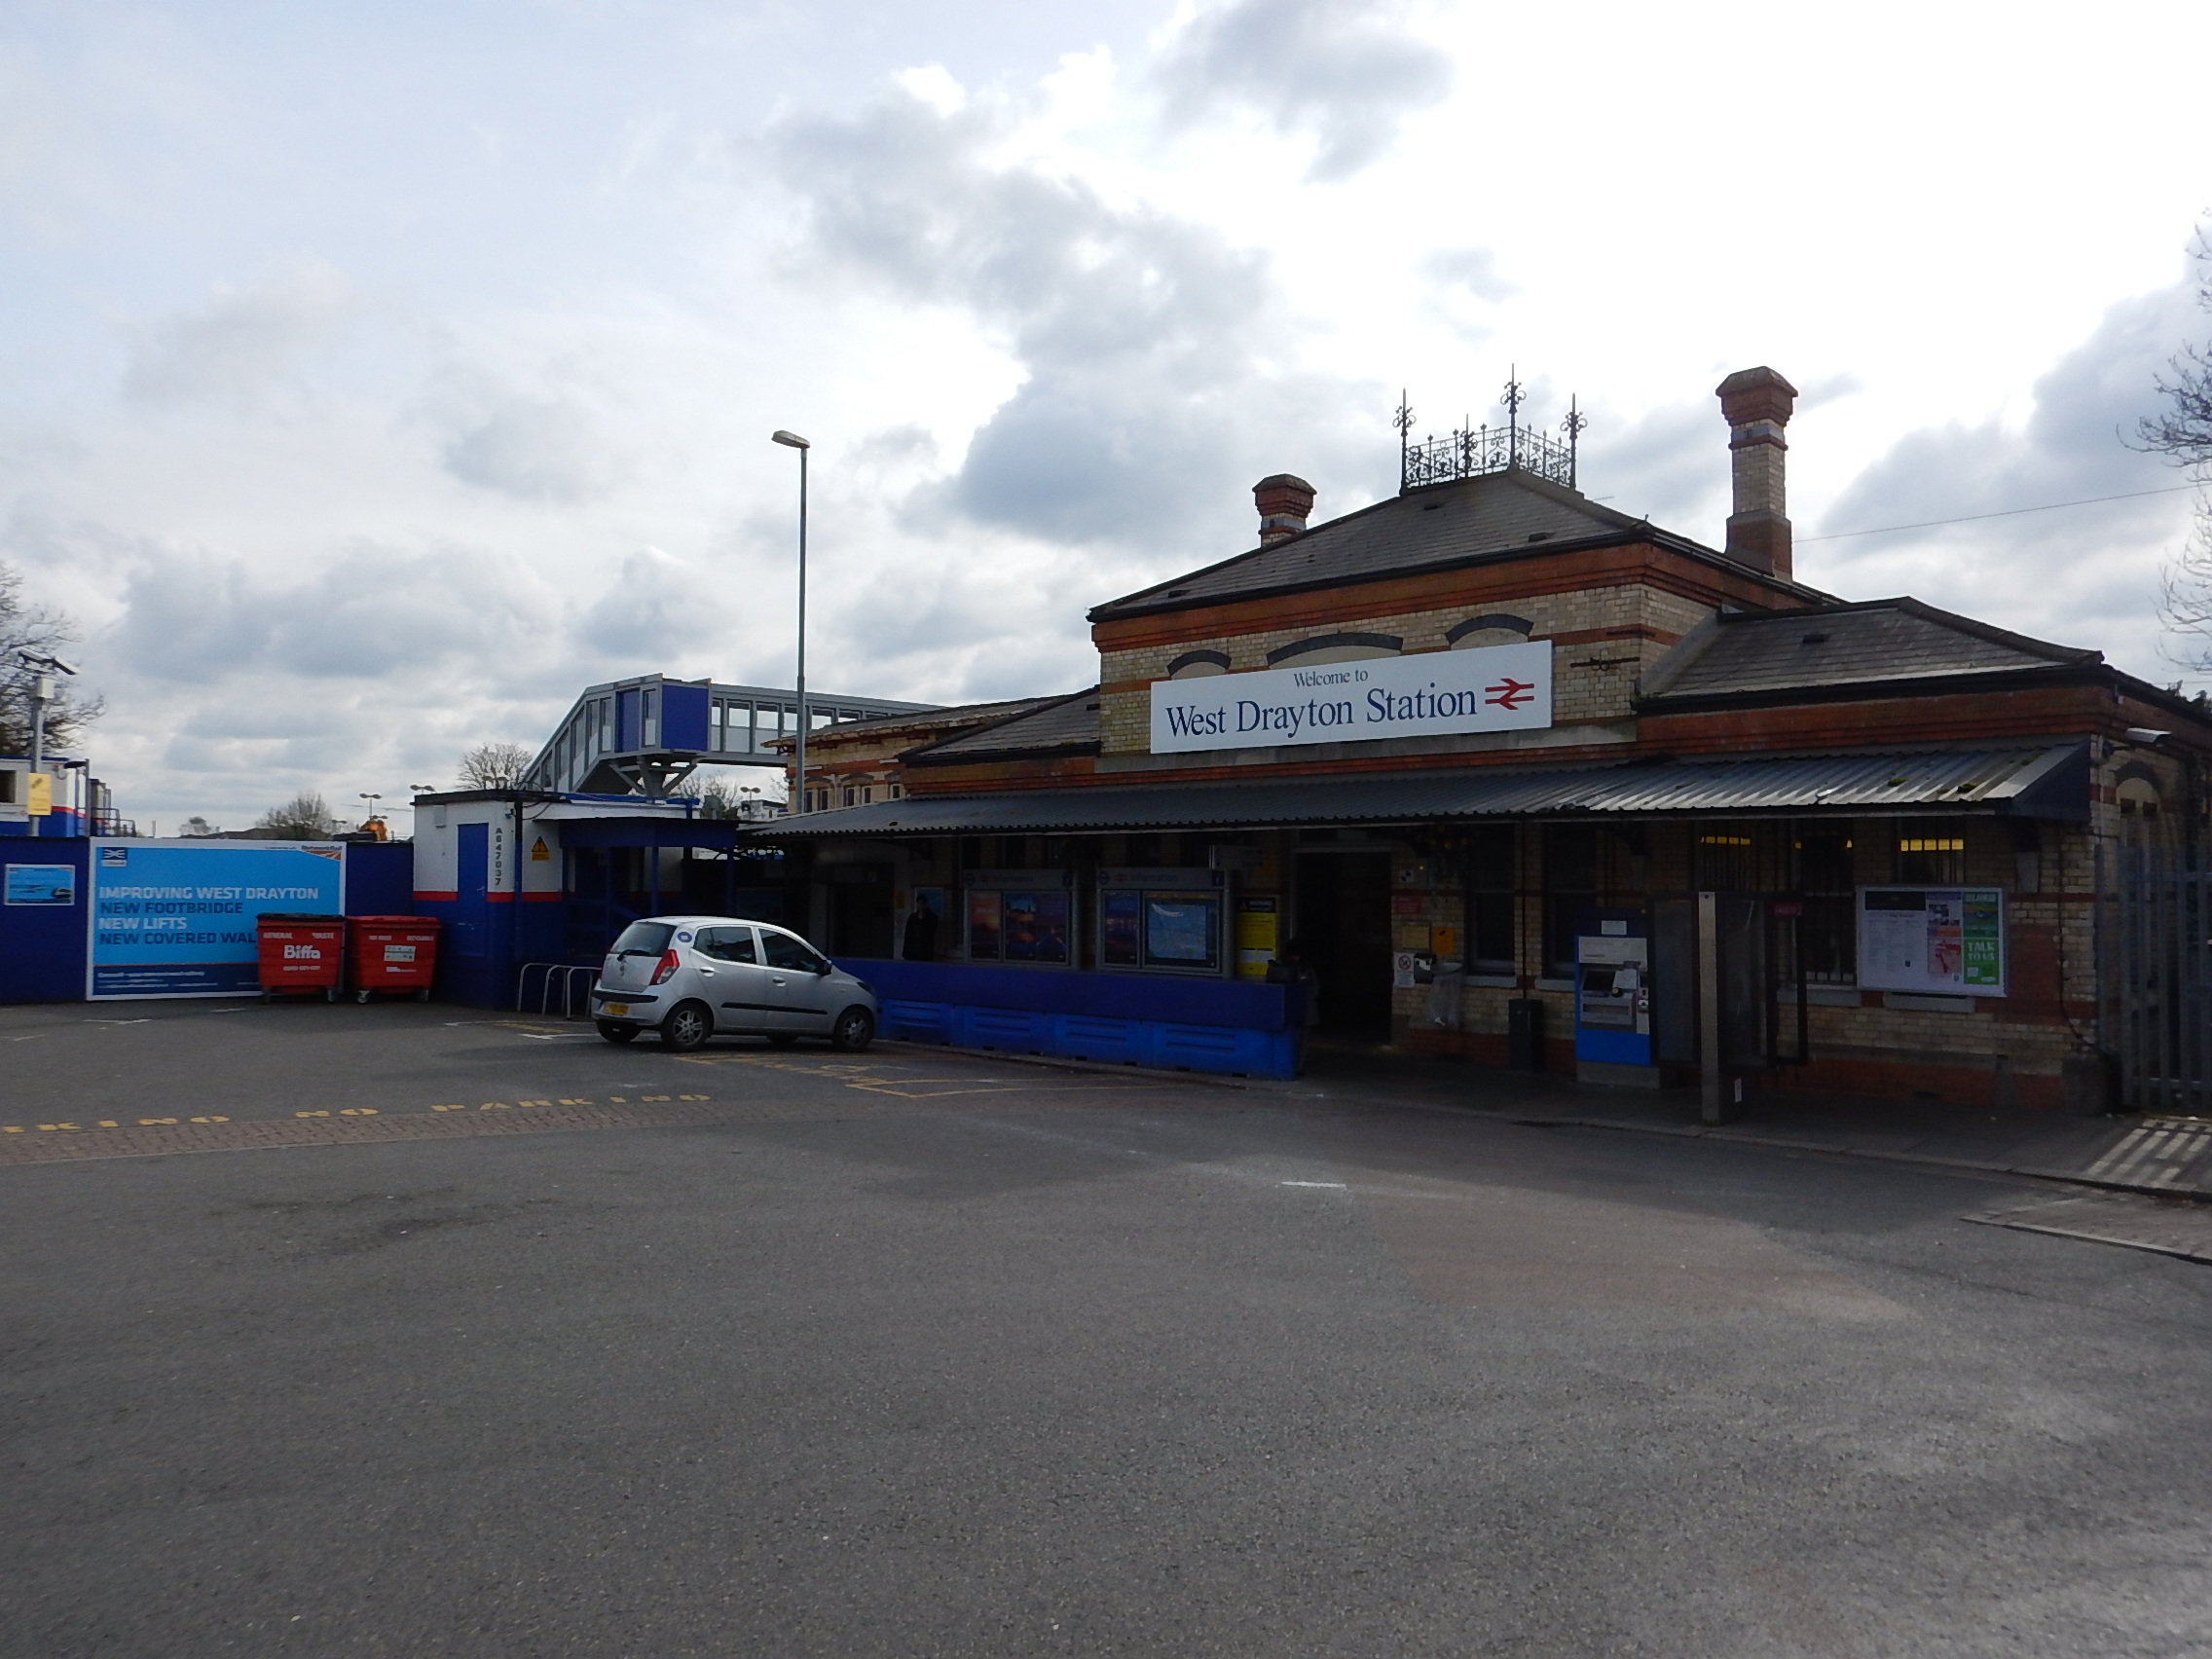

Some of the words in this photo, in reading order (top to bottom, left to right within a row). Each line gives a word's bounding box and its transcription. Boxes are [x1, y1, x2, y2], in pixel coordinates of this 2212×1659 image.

[1293, 671, 1351, 688] Welcome
[1354, 668, 1369, 682] to
[1165, 705, 1227, 738] West
[1235, 698, 1353, 739] Drayton
[1366, 682, 1478, 723] Station
[98, 886, 193, 900] IMPROVING
[197, 886, 243, 900] WEST
[245, 887, 319, 900] DRAYTON
[100, 902, 141, 915] NEW
[145, 902, 243, 915] FOOTBRIDGE
[98, 916, 141, 930] NEW
[143, 916, 188, 930] LIFTS
[99, 932, 141, 945] NEW
[144, 932, 217, 945] COVERED
[283, 944, 321, 959] Biffa
[1968, 941, 1995, 951] TALK
